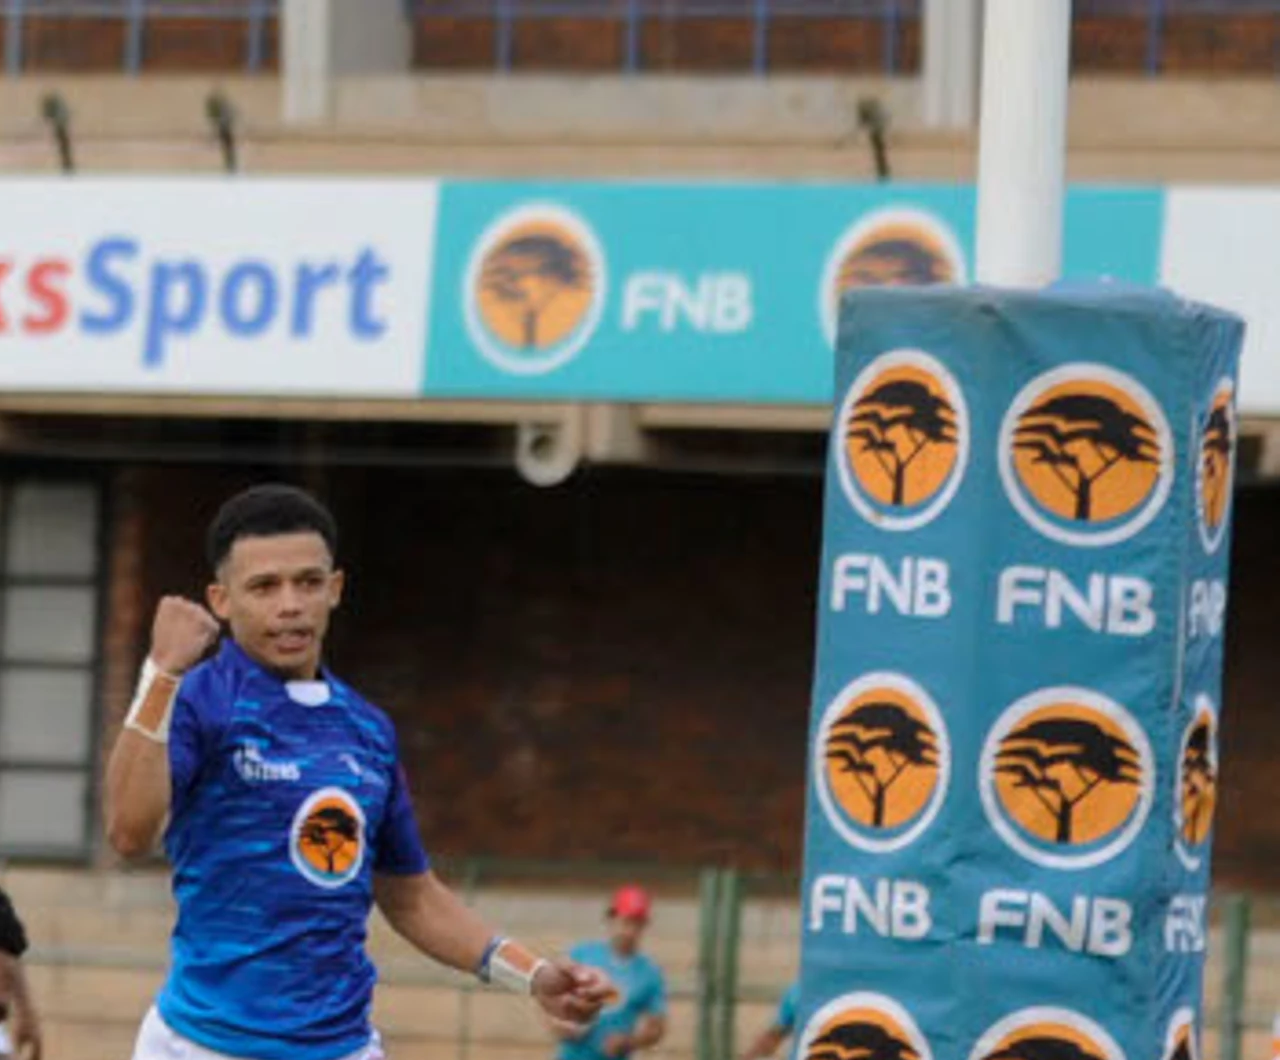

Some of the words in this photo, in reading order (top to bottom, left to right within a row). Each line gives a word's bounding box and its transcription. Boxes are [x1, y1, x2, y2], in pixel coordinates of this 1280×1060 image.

[620, 271, 753, 334] FNB
[830, 555, 952, 618] FNB
[995, 566, 1157, 637] FNB
[808, 873, 933, 940] FNB
[975, 888, 1134, 957] FNB
